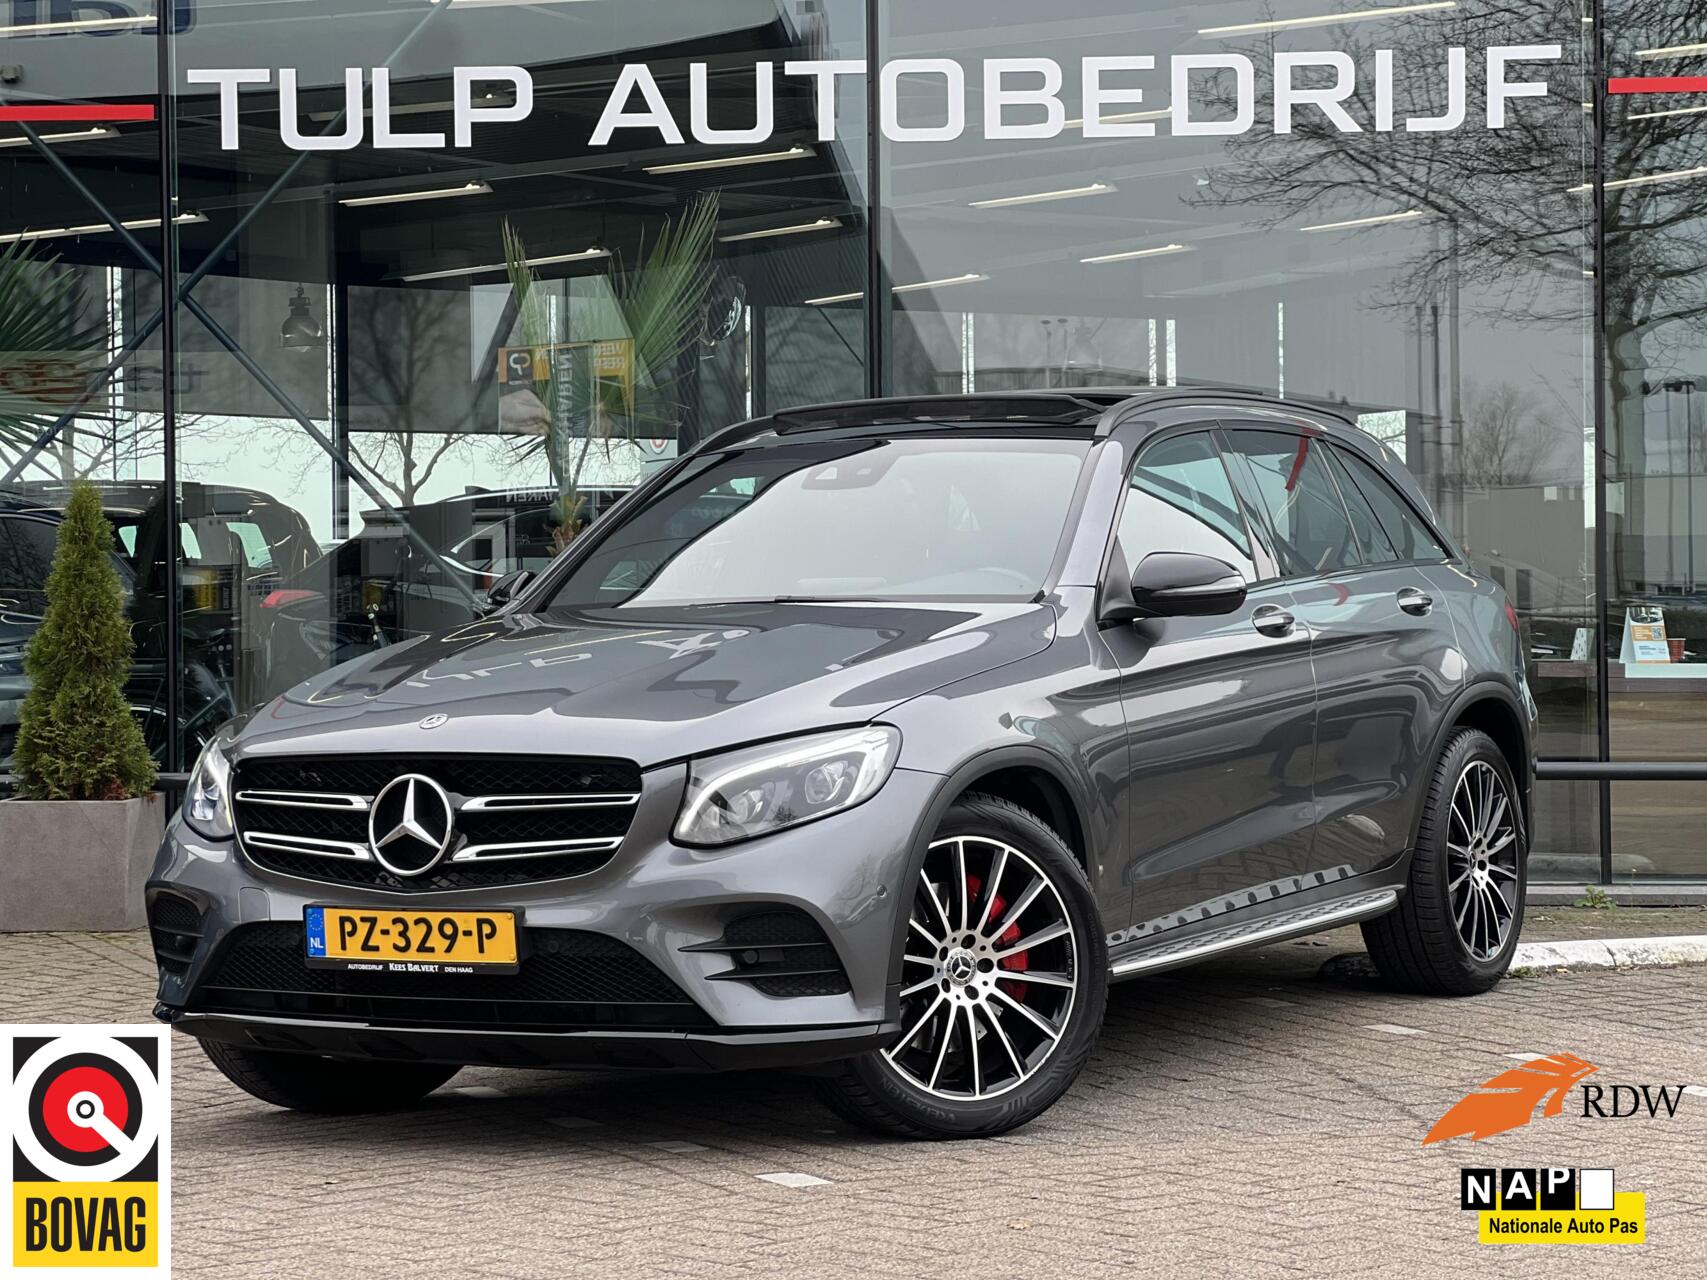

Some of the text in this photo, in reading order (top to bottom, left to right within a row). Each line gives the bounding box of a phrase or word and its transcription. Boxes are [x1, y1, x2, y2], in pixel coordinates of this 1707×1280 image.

[187, 44, 1562, 151] TULP AUTOBEDRIJF
[310, 938, 324, 949] NL
[338, 915, 498, 954] PZ-329-P
[347, 963, 384, 971] AUTOBEDRIJF
